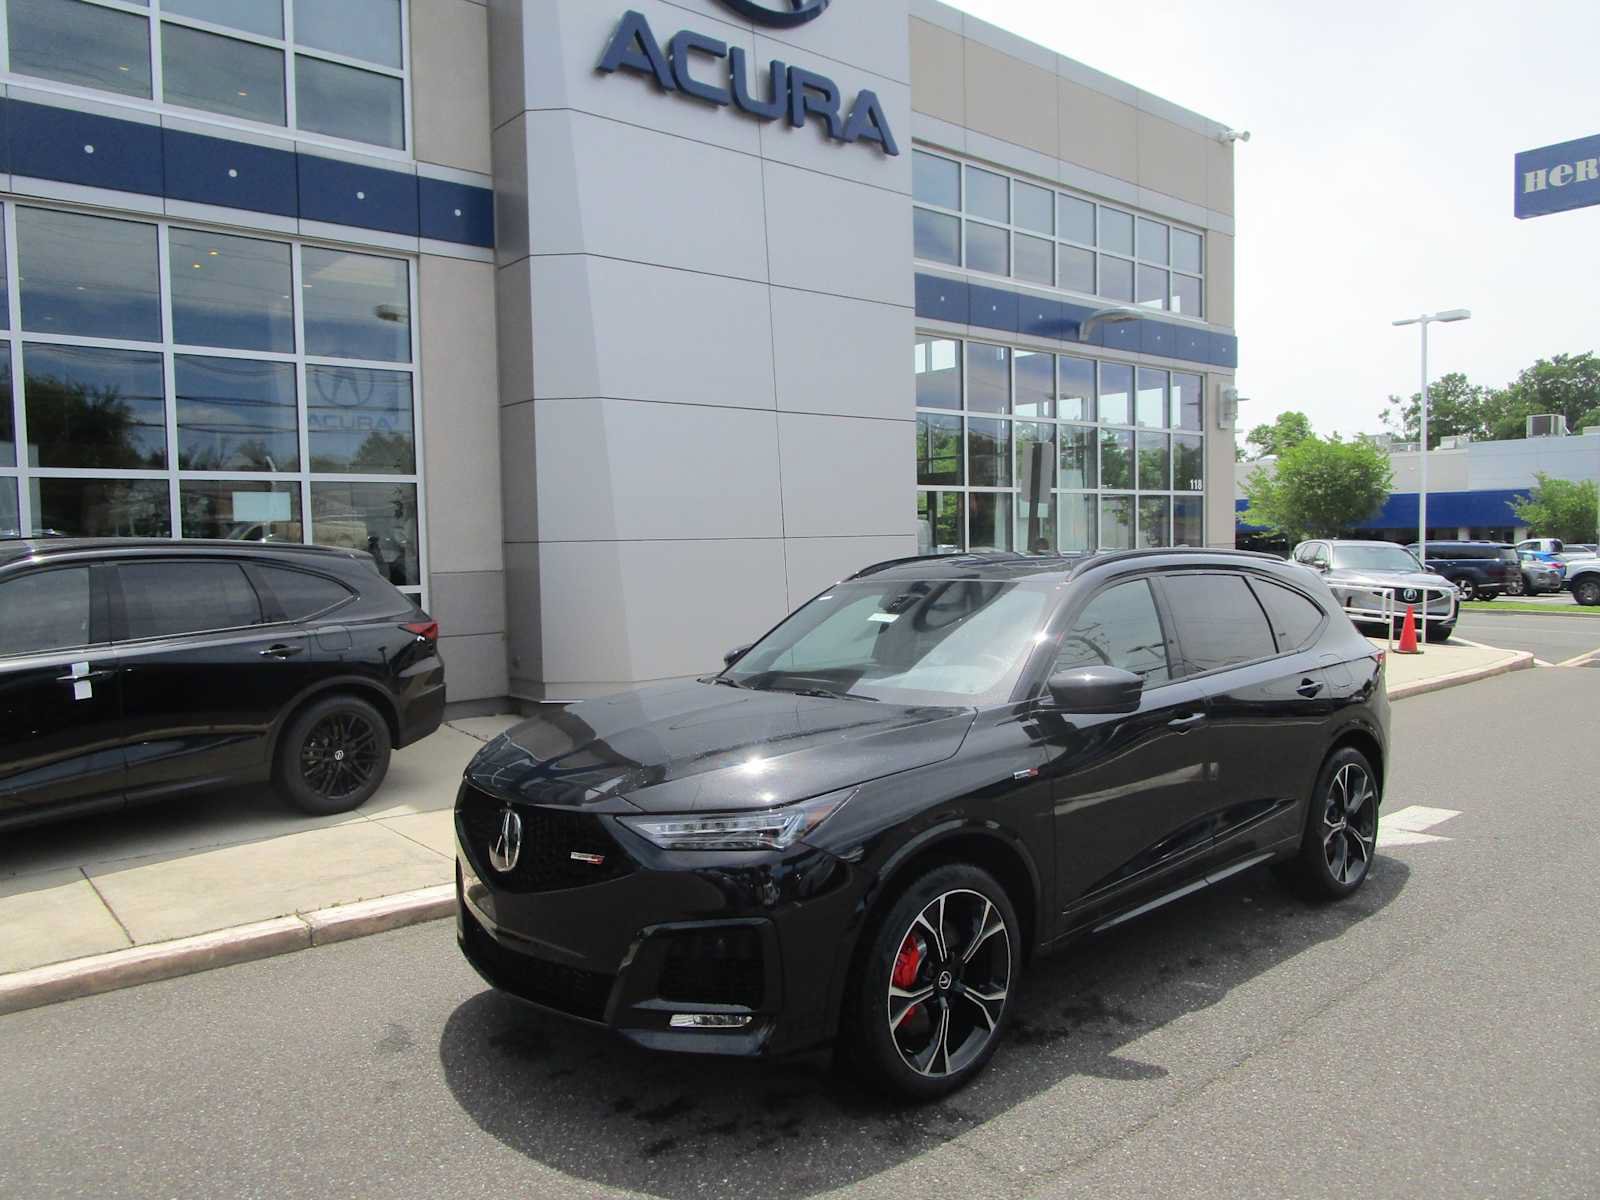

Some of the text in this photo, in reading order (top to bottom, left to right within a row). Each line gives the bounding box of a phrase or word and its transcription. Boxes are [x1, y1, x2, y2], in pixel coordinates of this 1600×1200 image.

[597, 9, 899, 156] ACURA
[1523, 157, 1600, 194] HeR
[306, 414, 393, 433] ACURA
